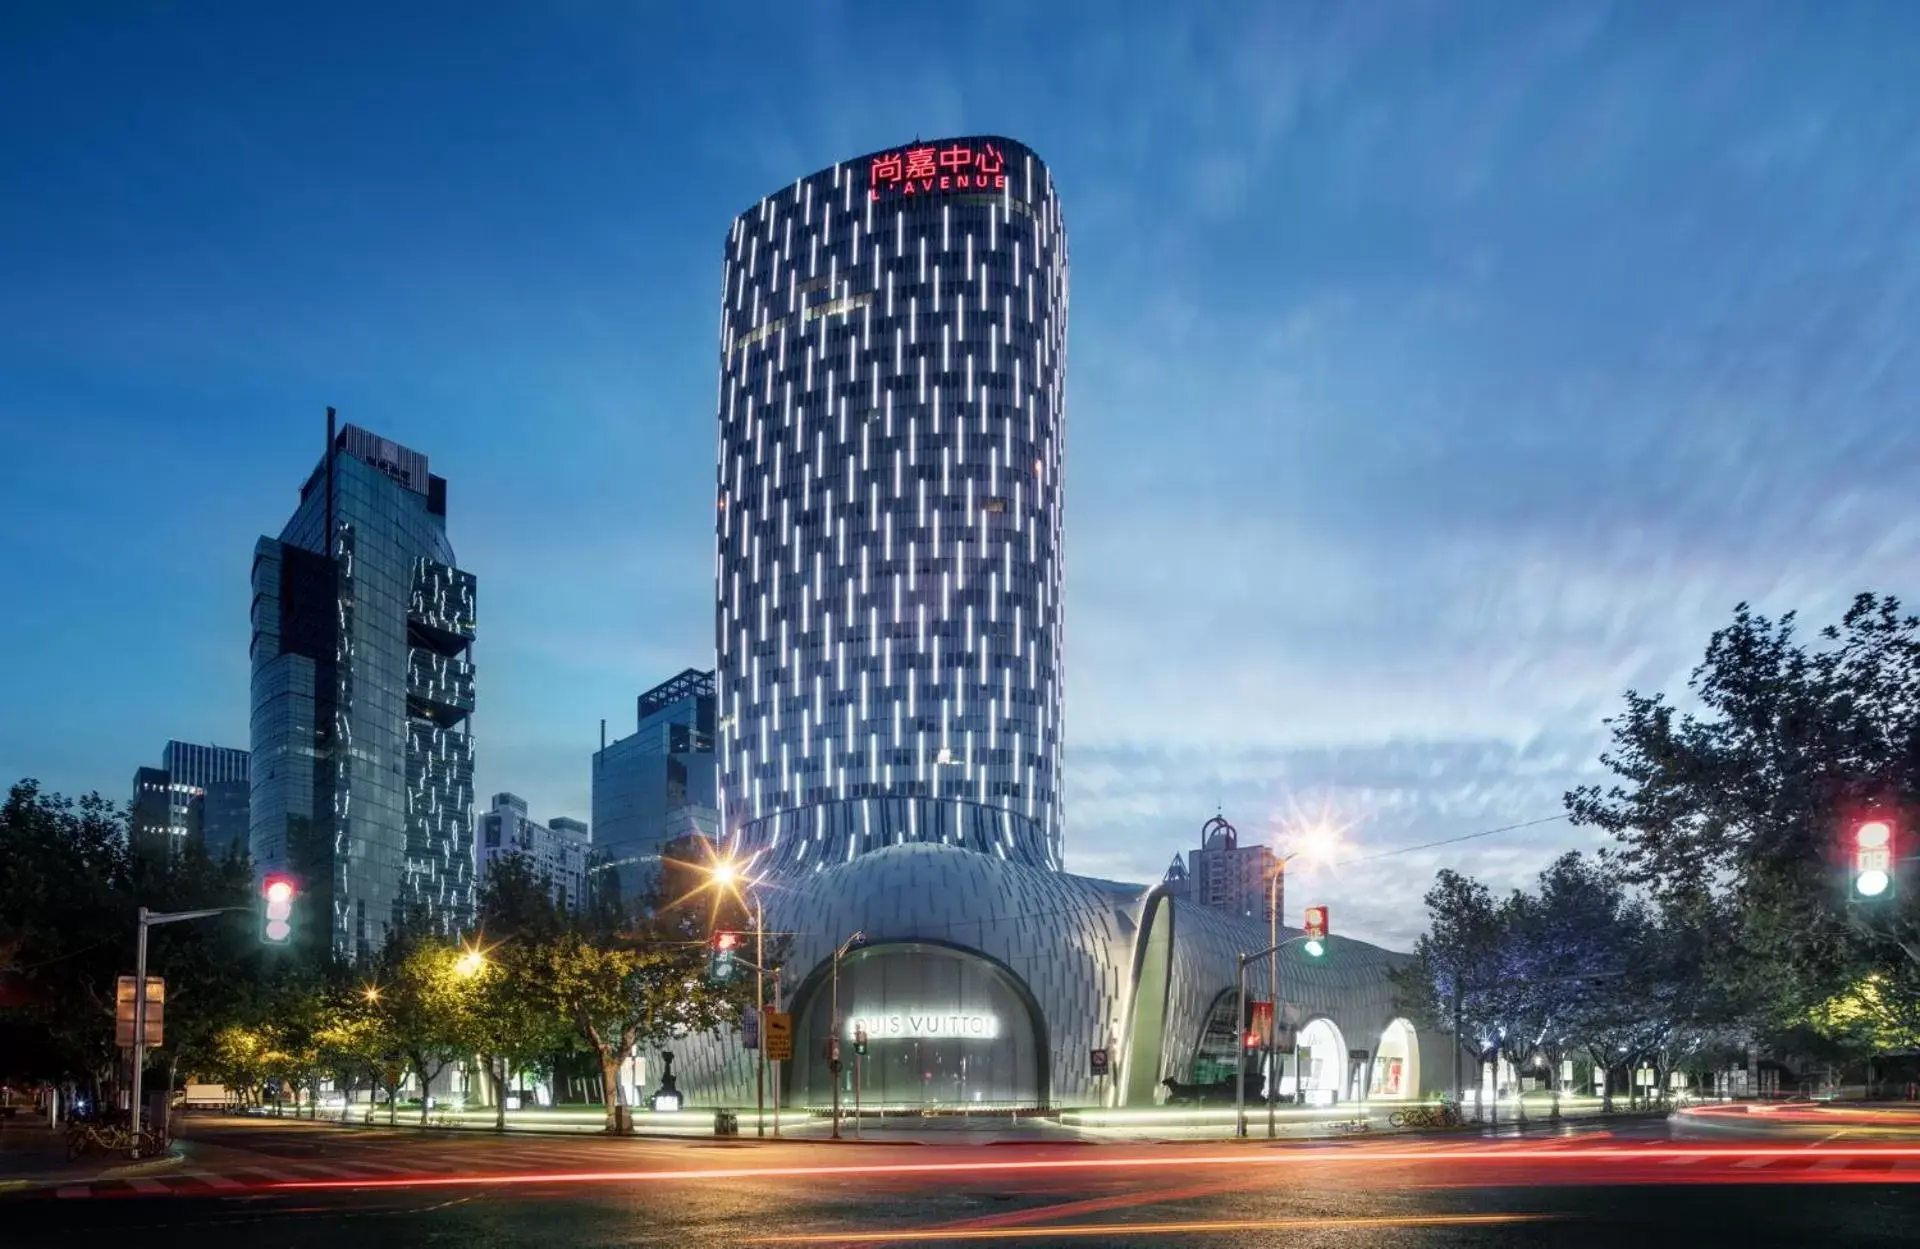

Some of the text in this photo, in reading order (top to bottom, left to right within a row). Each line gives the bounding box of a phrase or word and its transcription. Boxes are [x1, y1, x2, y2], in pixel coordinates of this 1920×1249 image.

[871, 143, 1004, 186] 尚嘉中心
[851, 1016, 997, 1034] OUIS VUITTO
